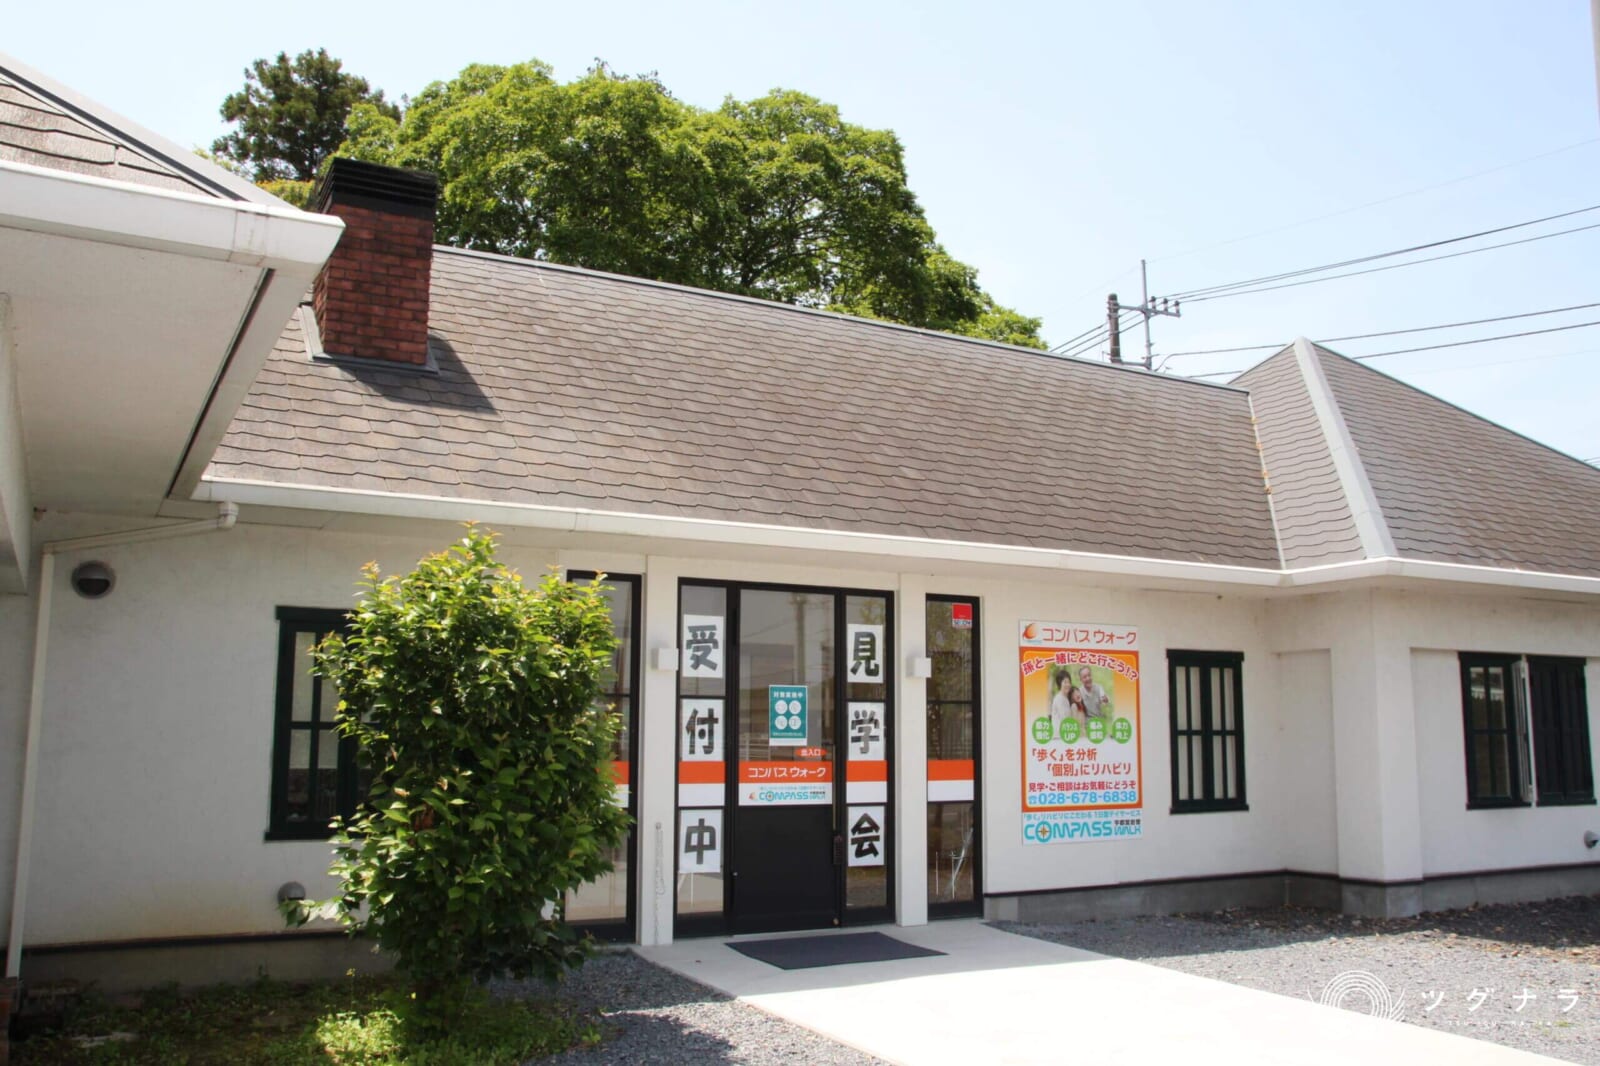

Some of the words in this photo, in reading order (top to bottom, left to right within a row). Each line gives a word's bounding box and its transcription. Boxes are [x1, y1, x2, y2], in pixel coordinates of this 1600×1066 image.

[1064, 732, 1077, 741] UP
[684, 624, 719, 865] 受付中
[850, 631, 880, 859] 見学会
[801, 748, 821, 757] 出入口
[1032, 748, 1097, 761] 「歩く」を分析
[1047, 762, 1131, 777] 「個別」にリハビリ
[759, 790, 808, 802] COMPASS
[1038, 791, 1137, 805] 028-678-6838
[1024, 821, 1112, 842] COMPASS
